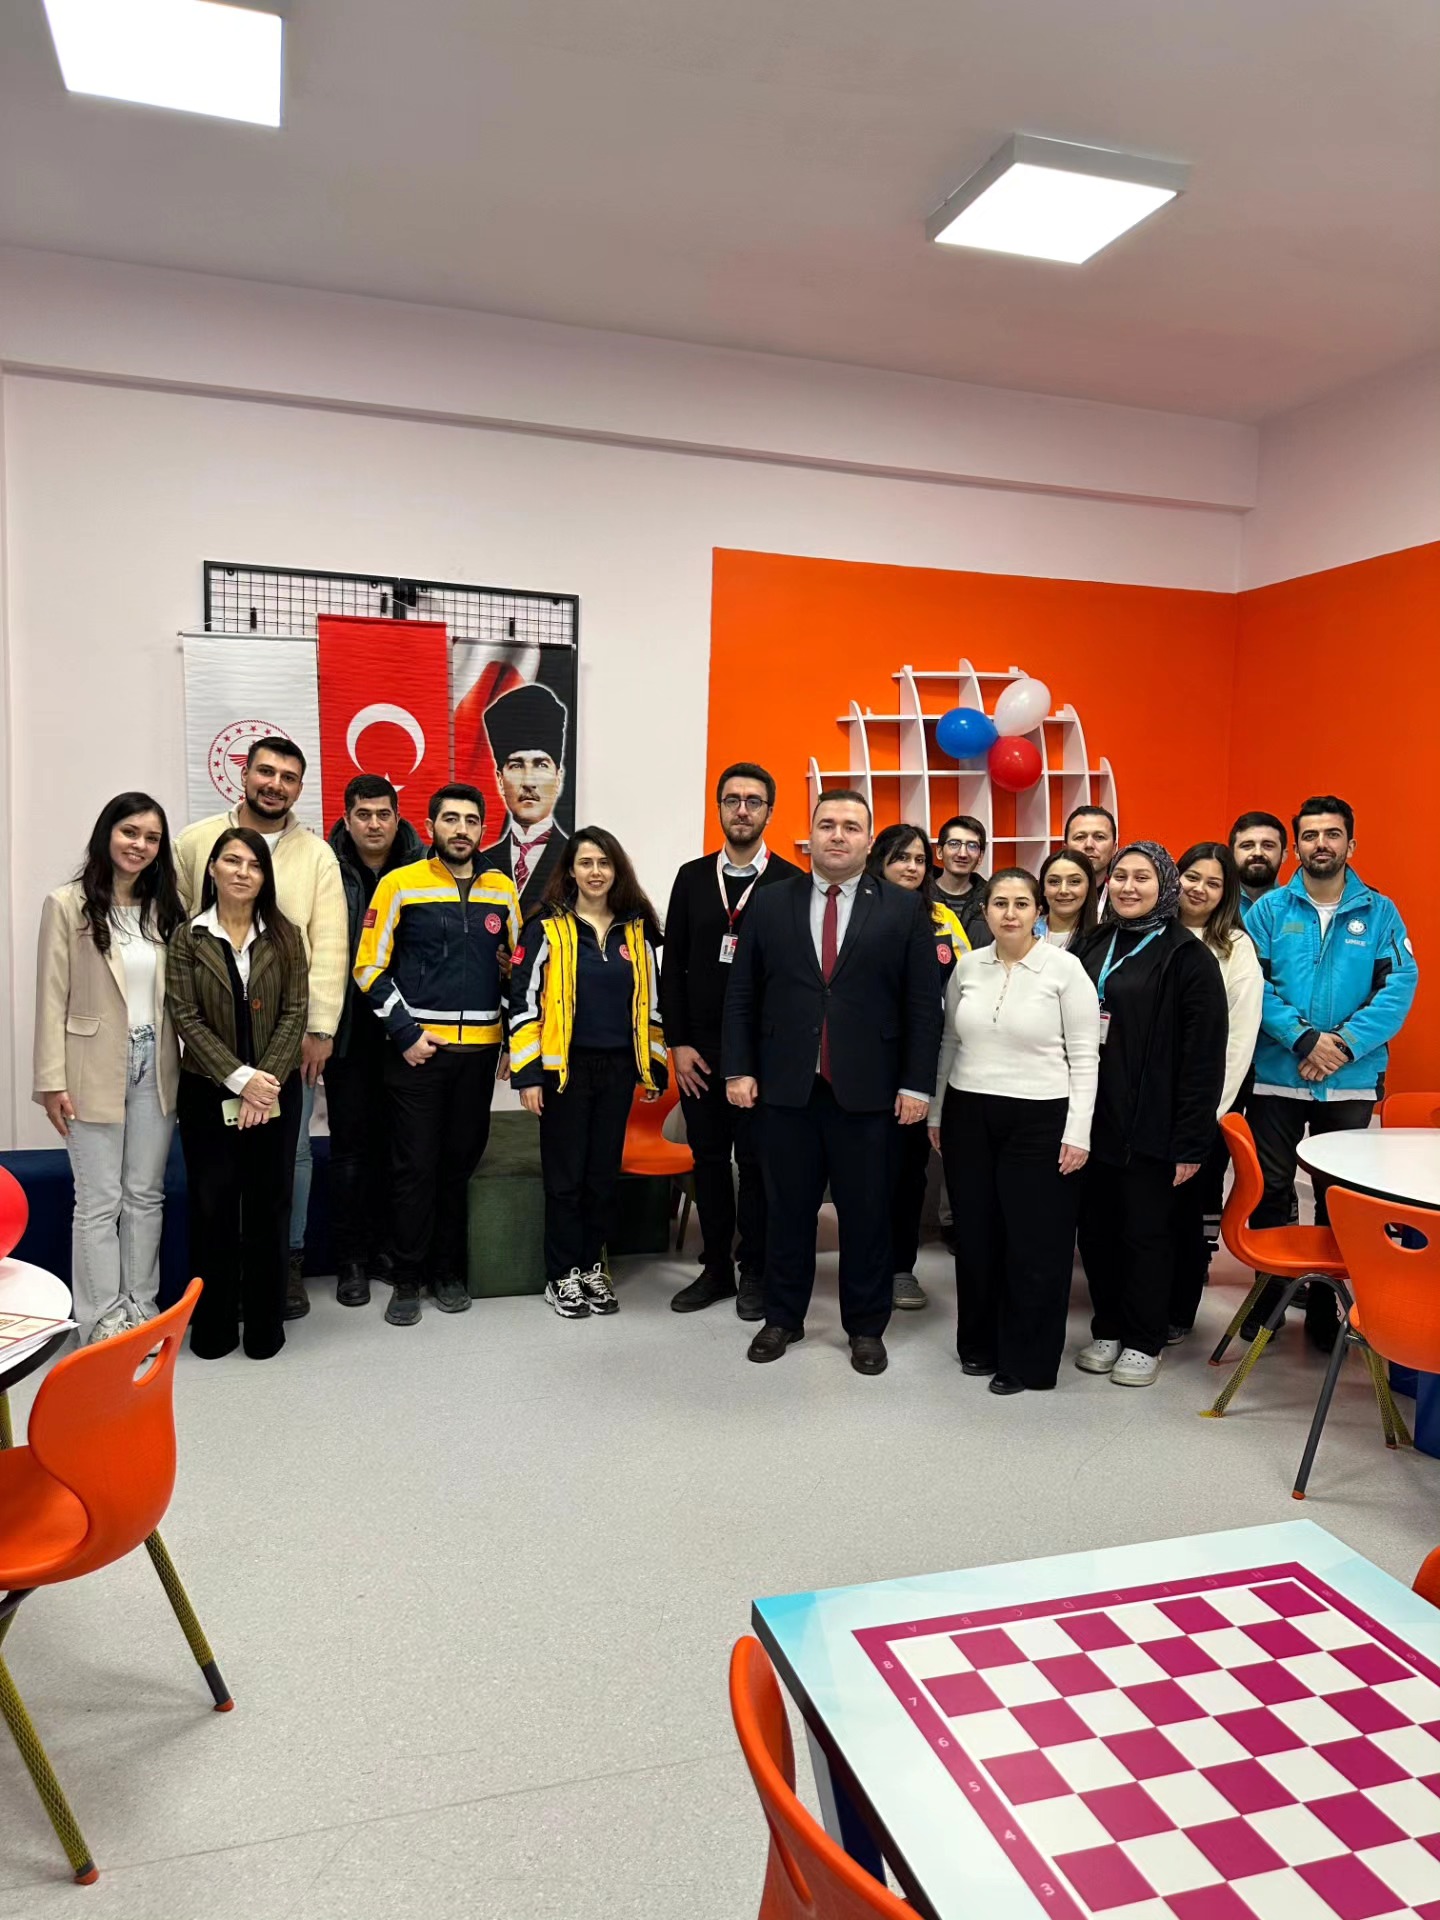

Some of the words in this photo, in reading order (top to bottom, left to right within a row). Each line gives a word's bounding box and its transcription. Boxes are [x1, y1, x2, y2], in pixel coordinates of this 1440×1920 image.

[883, 1660, 894, 1669] 8
[908, 1697, 917, 1706] 7
[938, 1737, 949, 1747] 6
[968, 1781, 981, 1792] 5
[1004, 1829, 1017, 1840] 4
[1040, 1882, 1055, 1896] 3
